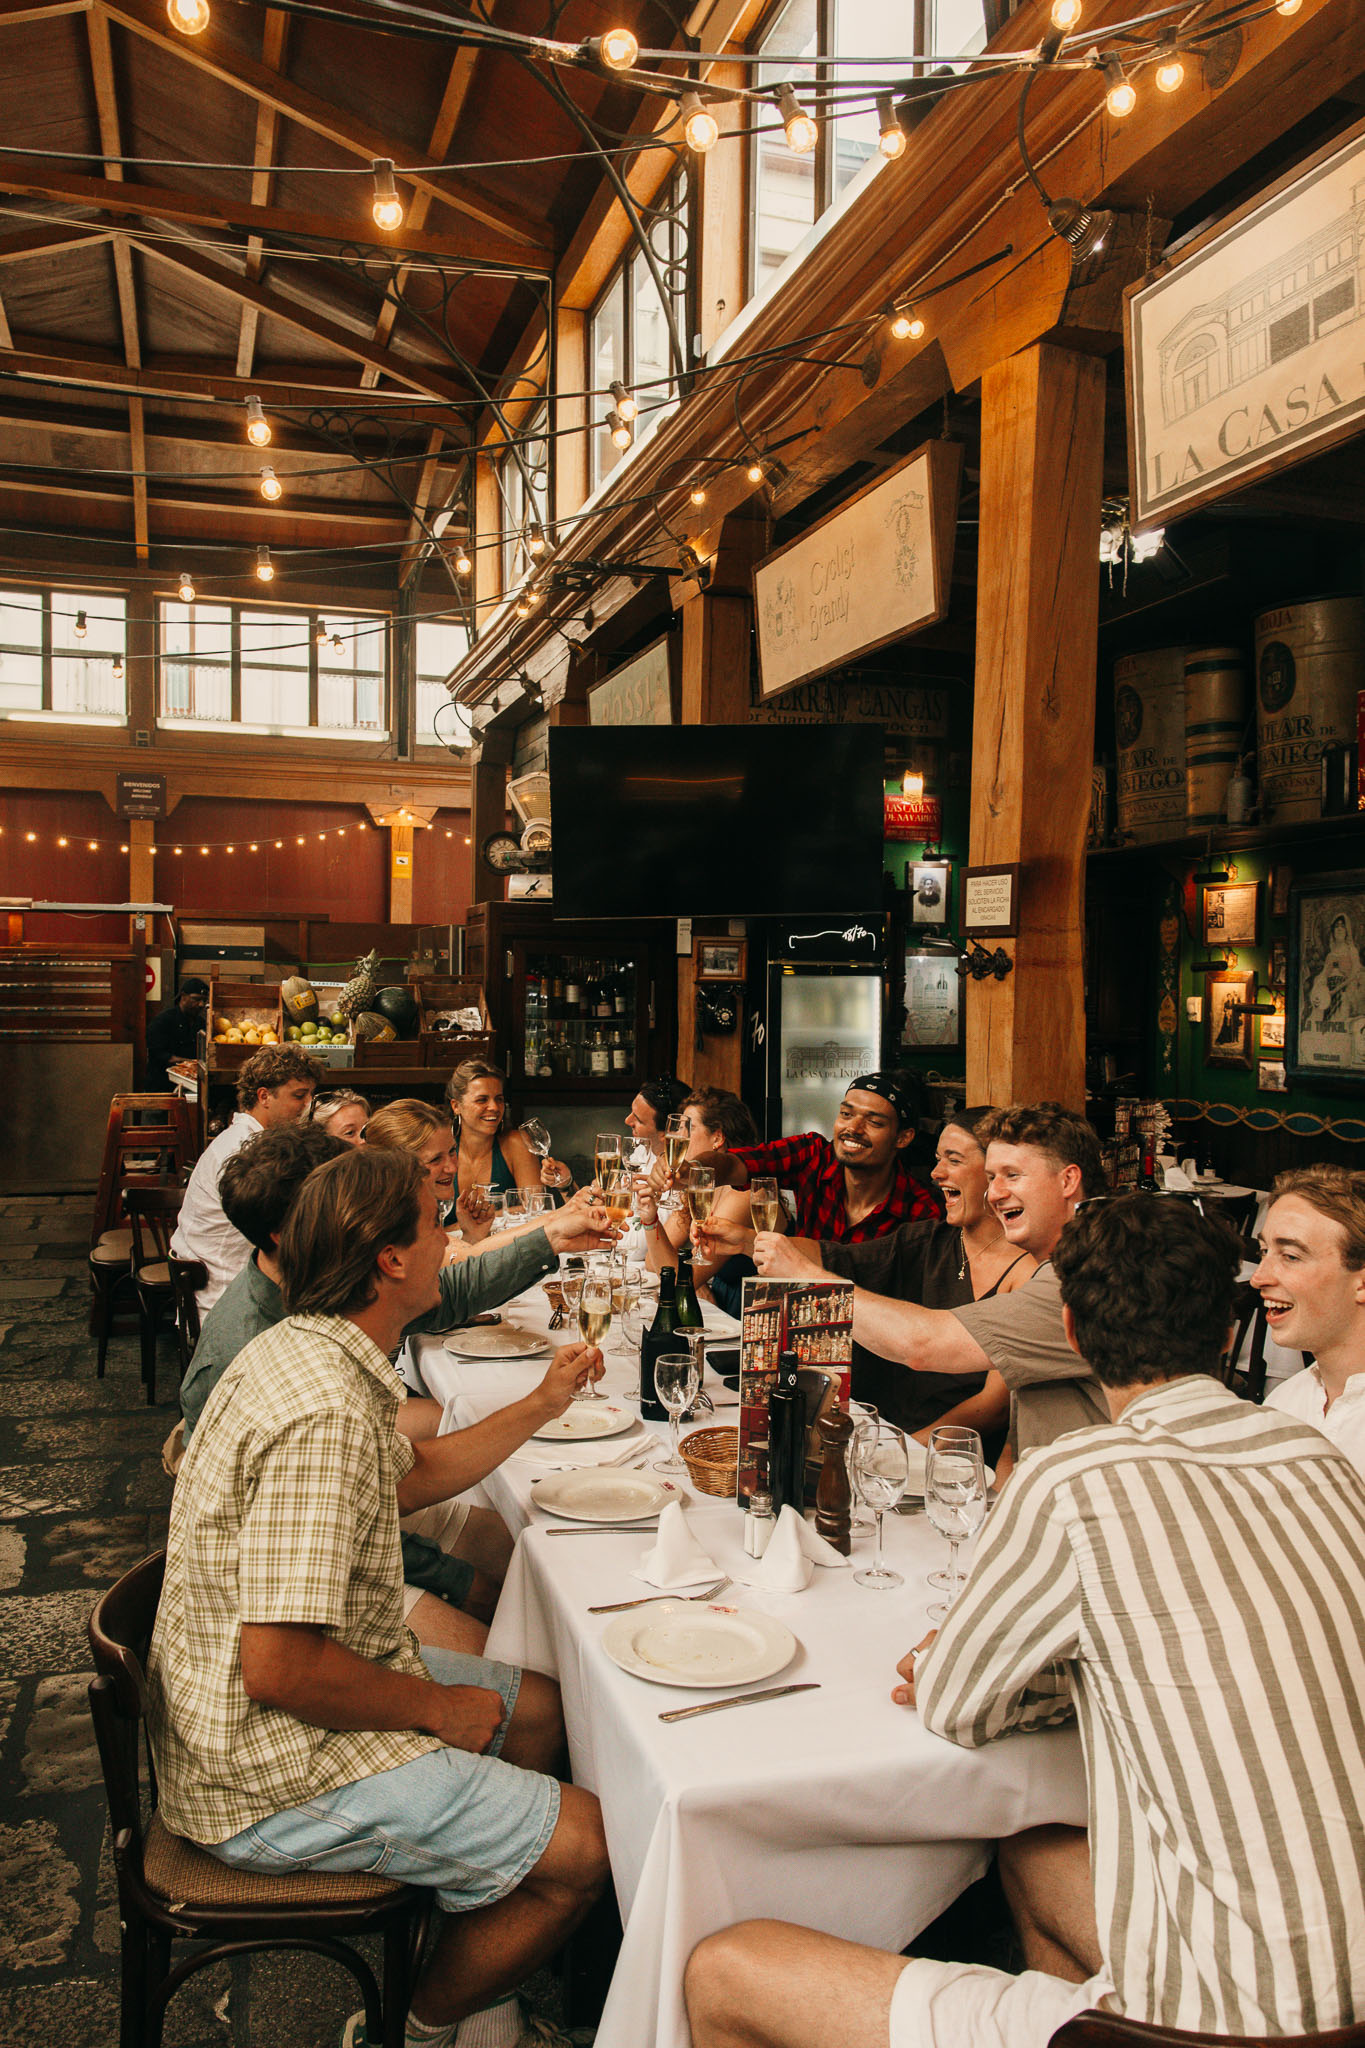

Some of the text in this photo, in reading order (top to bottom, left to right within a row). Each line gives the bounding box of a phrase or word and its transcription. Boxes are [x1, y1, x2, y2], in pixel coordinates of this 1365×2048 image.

[1151, 444, 1206, 496] LA
[1217, 373, 1347, 457] CASA
[123, 781, 161, 789] BIENVENIDOS
[998, 878, 1008, 886] USO
[983, 888, 1004, 896] SERVICIO
[978, 905, 1005, 913] ENCARGADO
[842, 924, 868, 942] 18/70
[786, 1068, 798, 1078] LA
[800, 1068, 823, 1078] CASA
[840, 1068, 874, 1078] INDIAN
